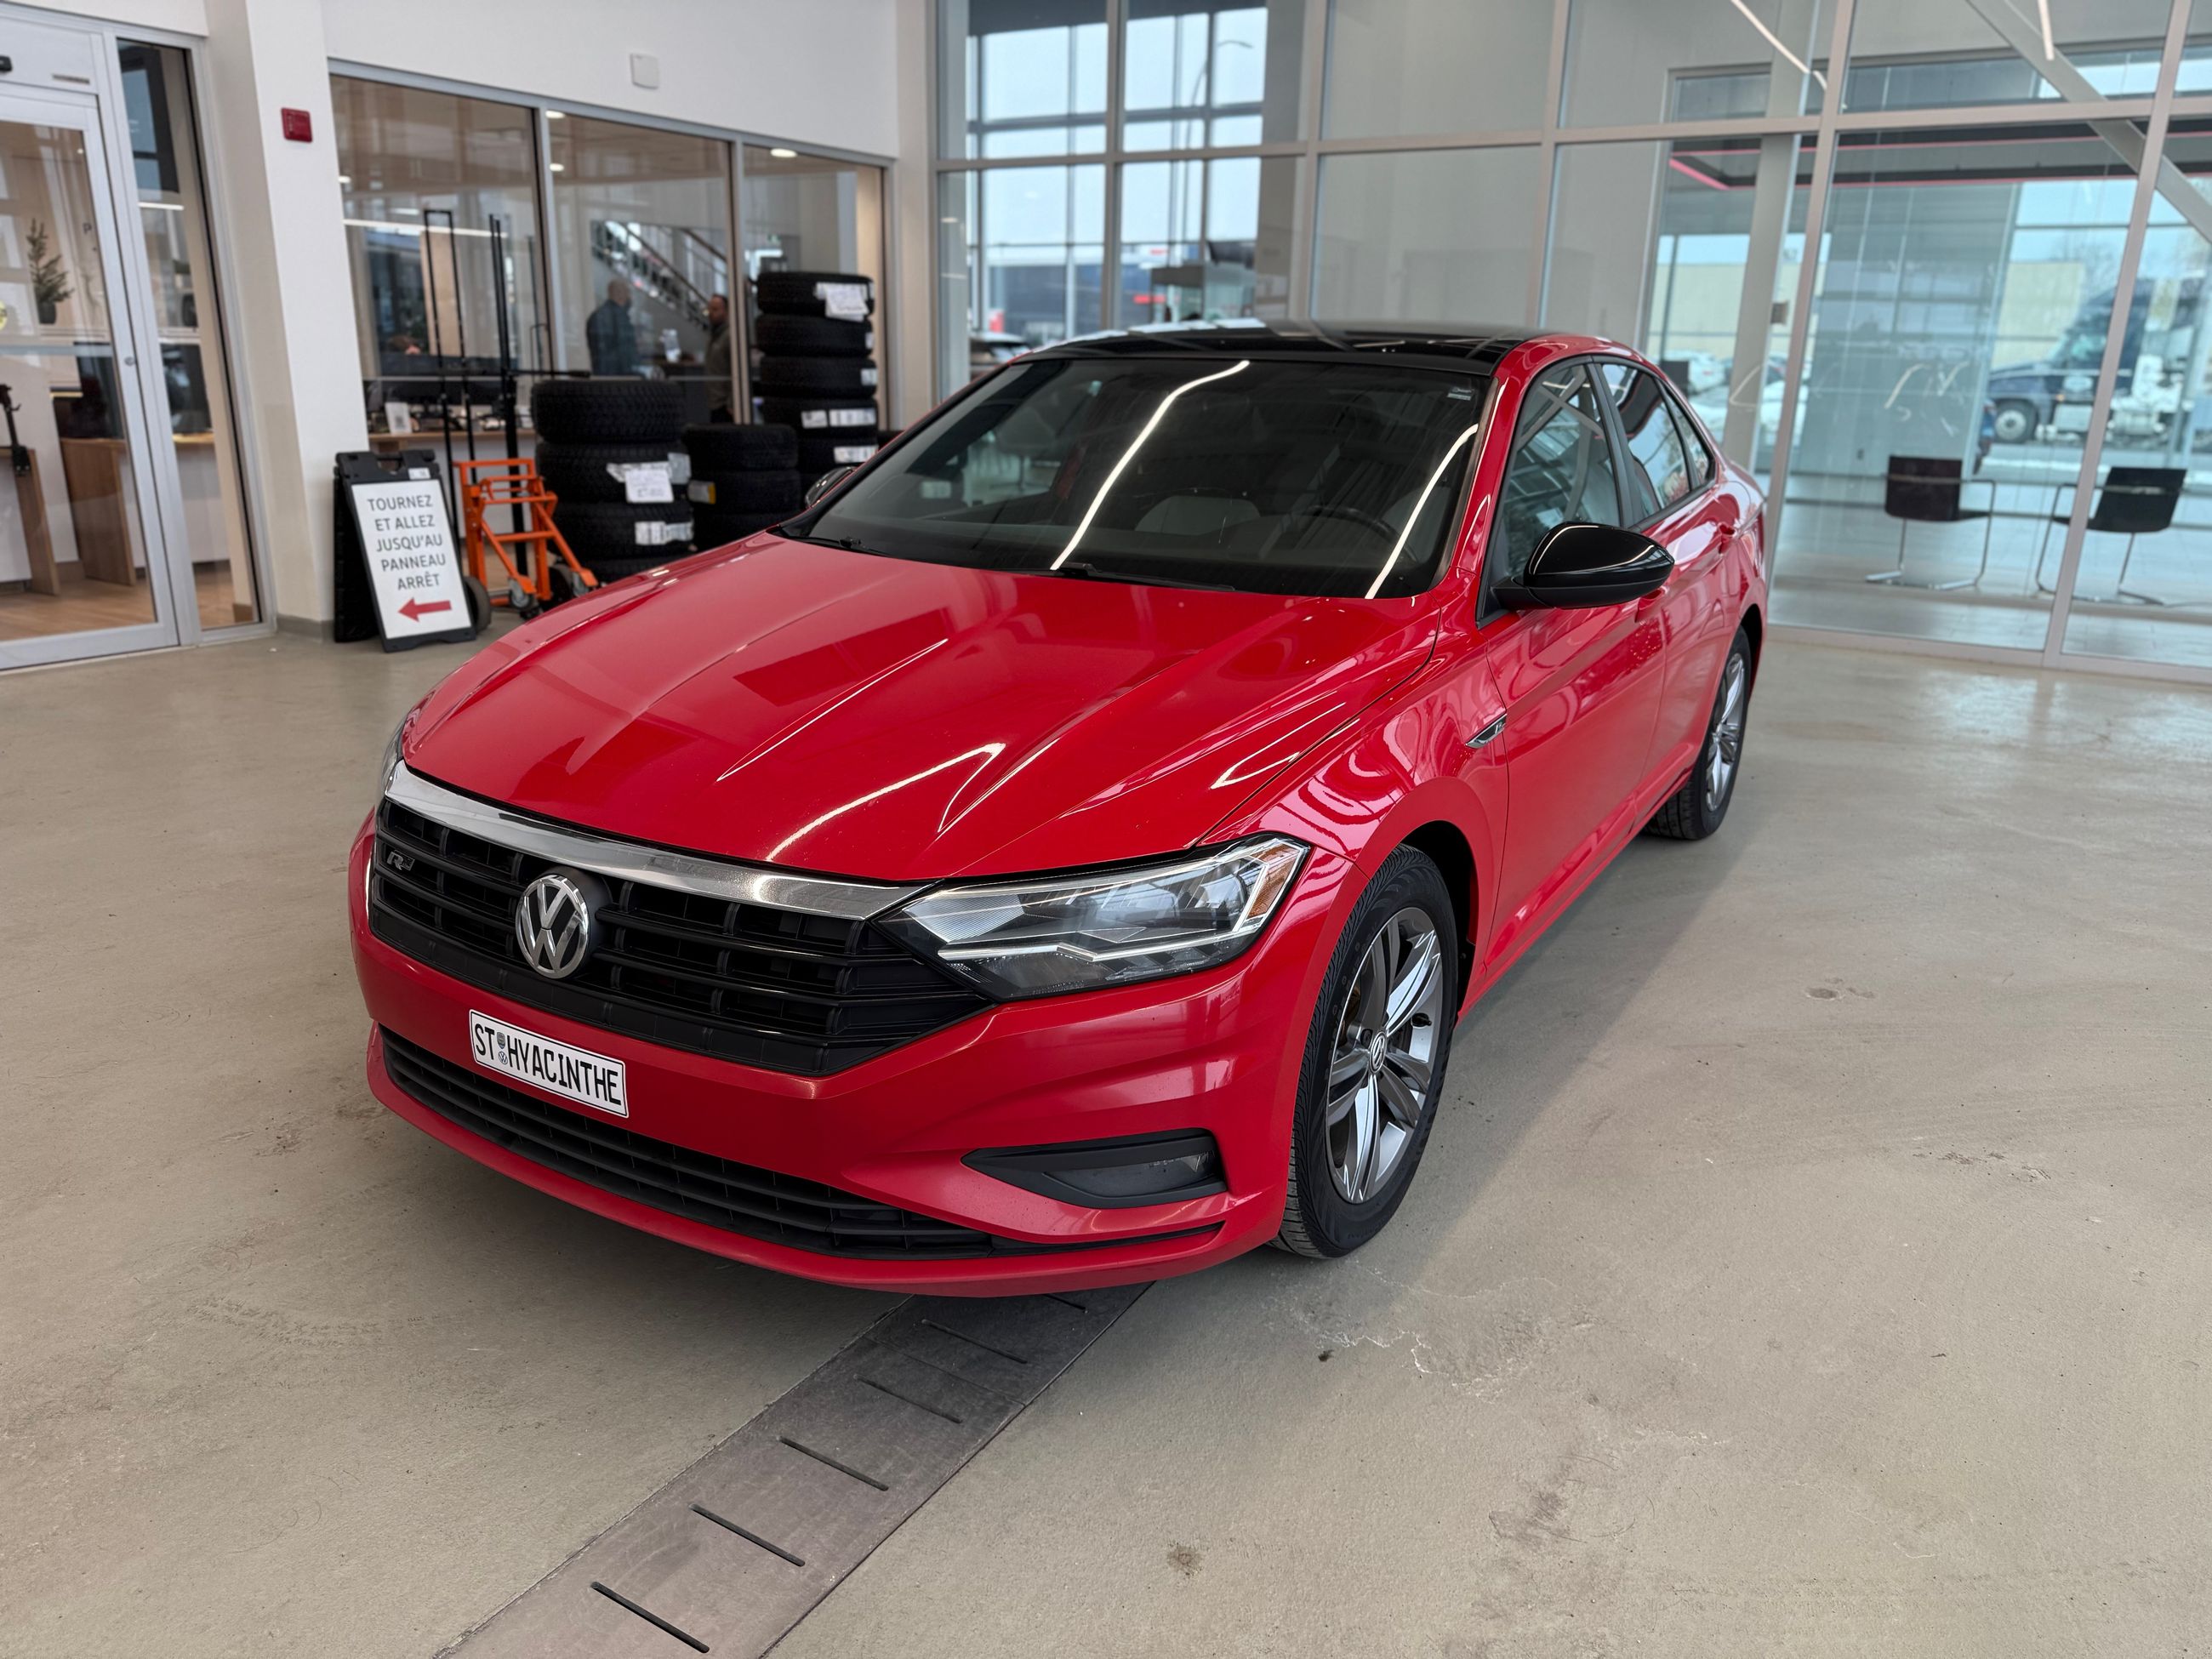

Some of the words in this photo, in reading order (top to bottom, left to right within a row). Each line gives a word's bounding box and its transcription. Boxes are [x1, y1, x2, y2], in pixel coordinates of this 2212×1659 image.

[368, 495, 432, 511] TOURNEZ
[375, 518, 391, 532] ET
[395, 515, 435, 529] ALLEZ
[376, 534, 442, 552] JUSQU'AU
[381, 554, 446, 573] PANNEAU
[397, 572, 439, 590] ARRÊT
[475, 1023, 495, 1060] ST
[507, 1035, 622, 1106] HYACINTHE
